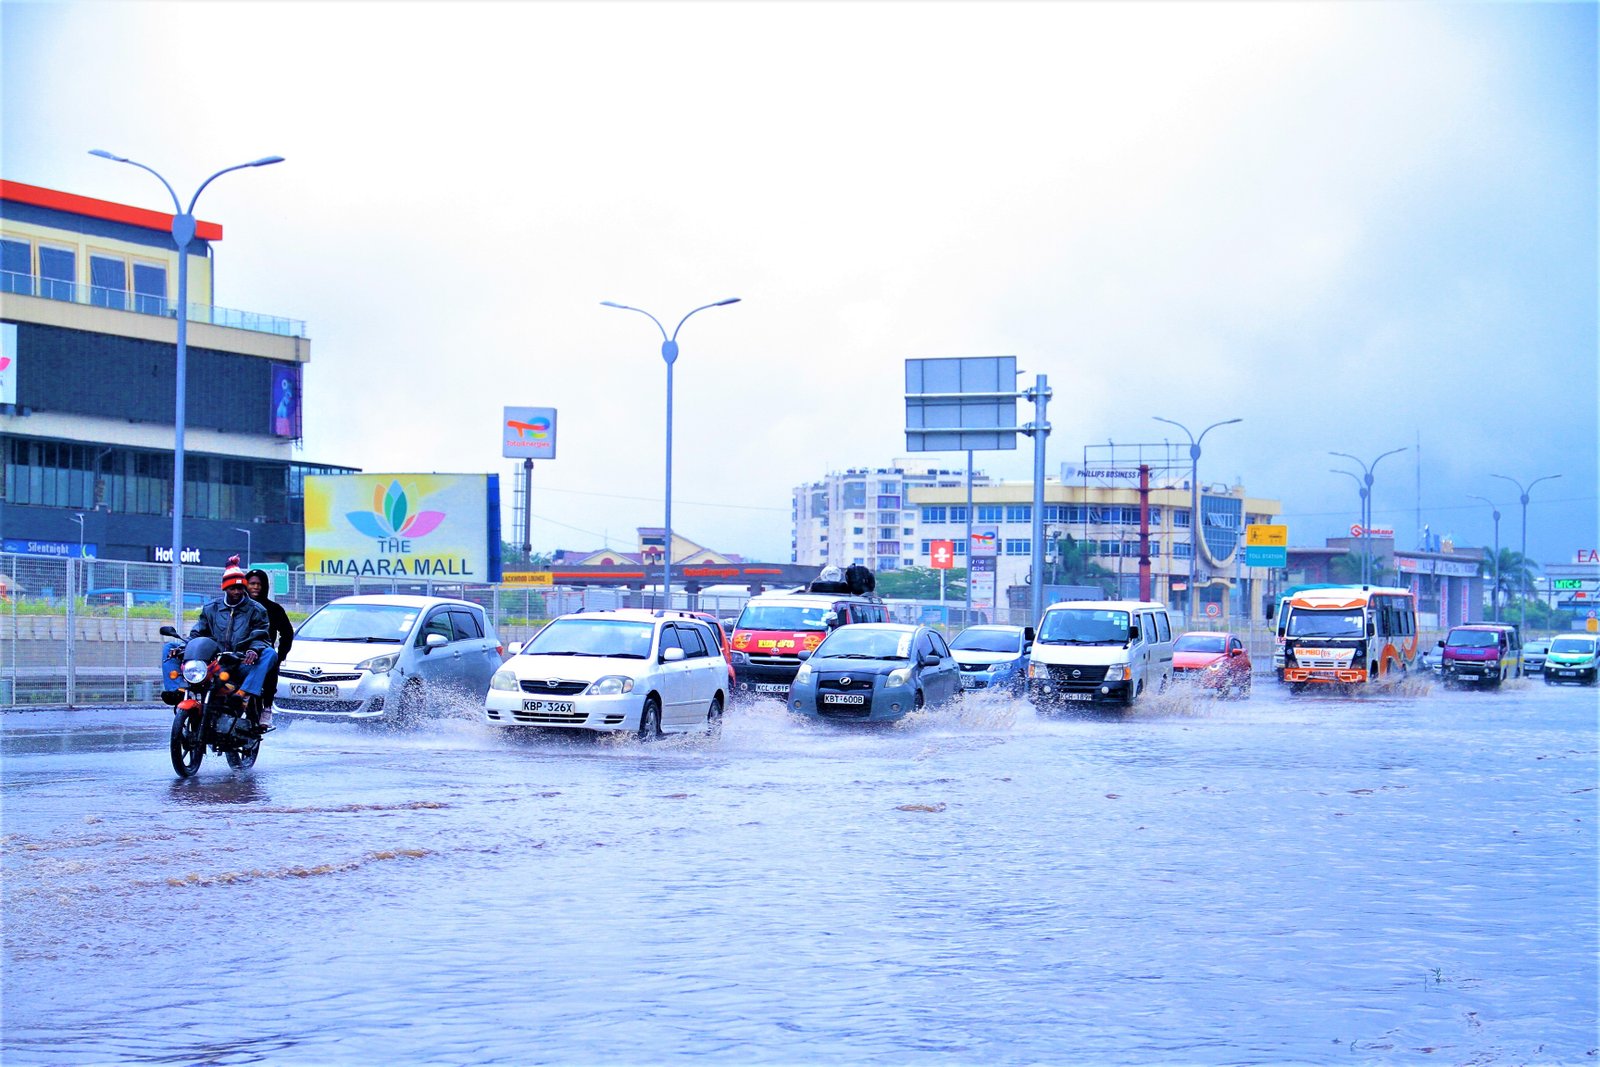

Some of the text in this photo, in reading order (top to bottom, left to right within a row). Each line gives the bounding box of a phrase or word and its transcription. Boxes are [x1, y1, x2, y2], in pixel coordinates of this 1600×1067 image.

[28, 541, 69, 556] Silentnight
[377, 538, 412, 553] THE
[155, 547, 200, 562] Hotoint
[320, 559, 474, 576] IMAARA MALL
